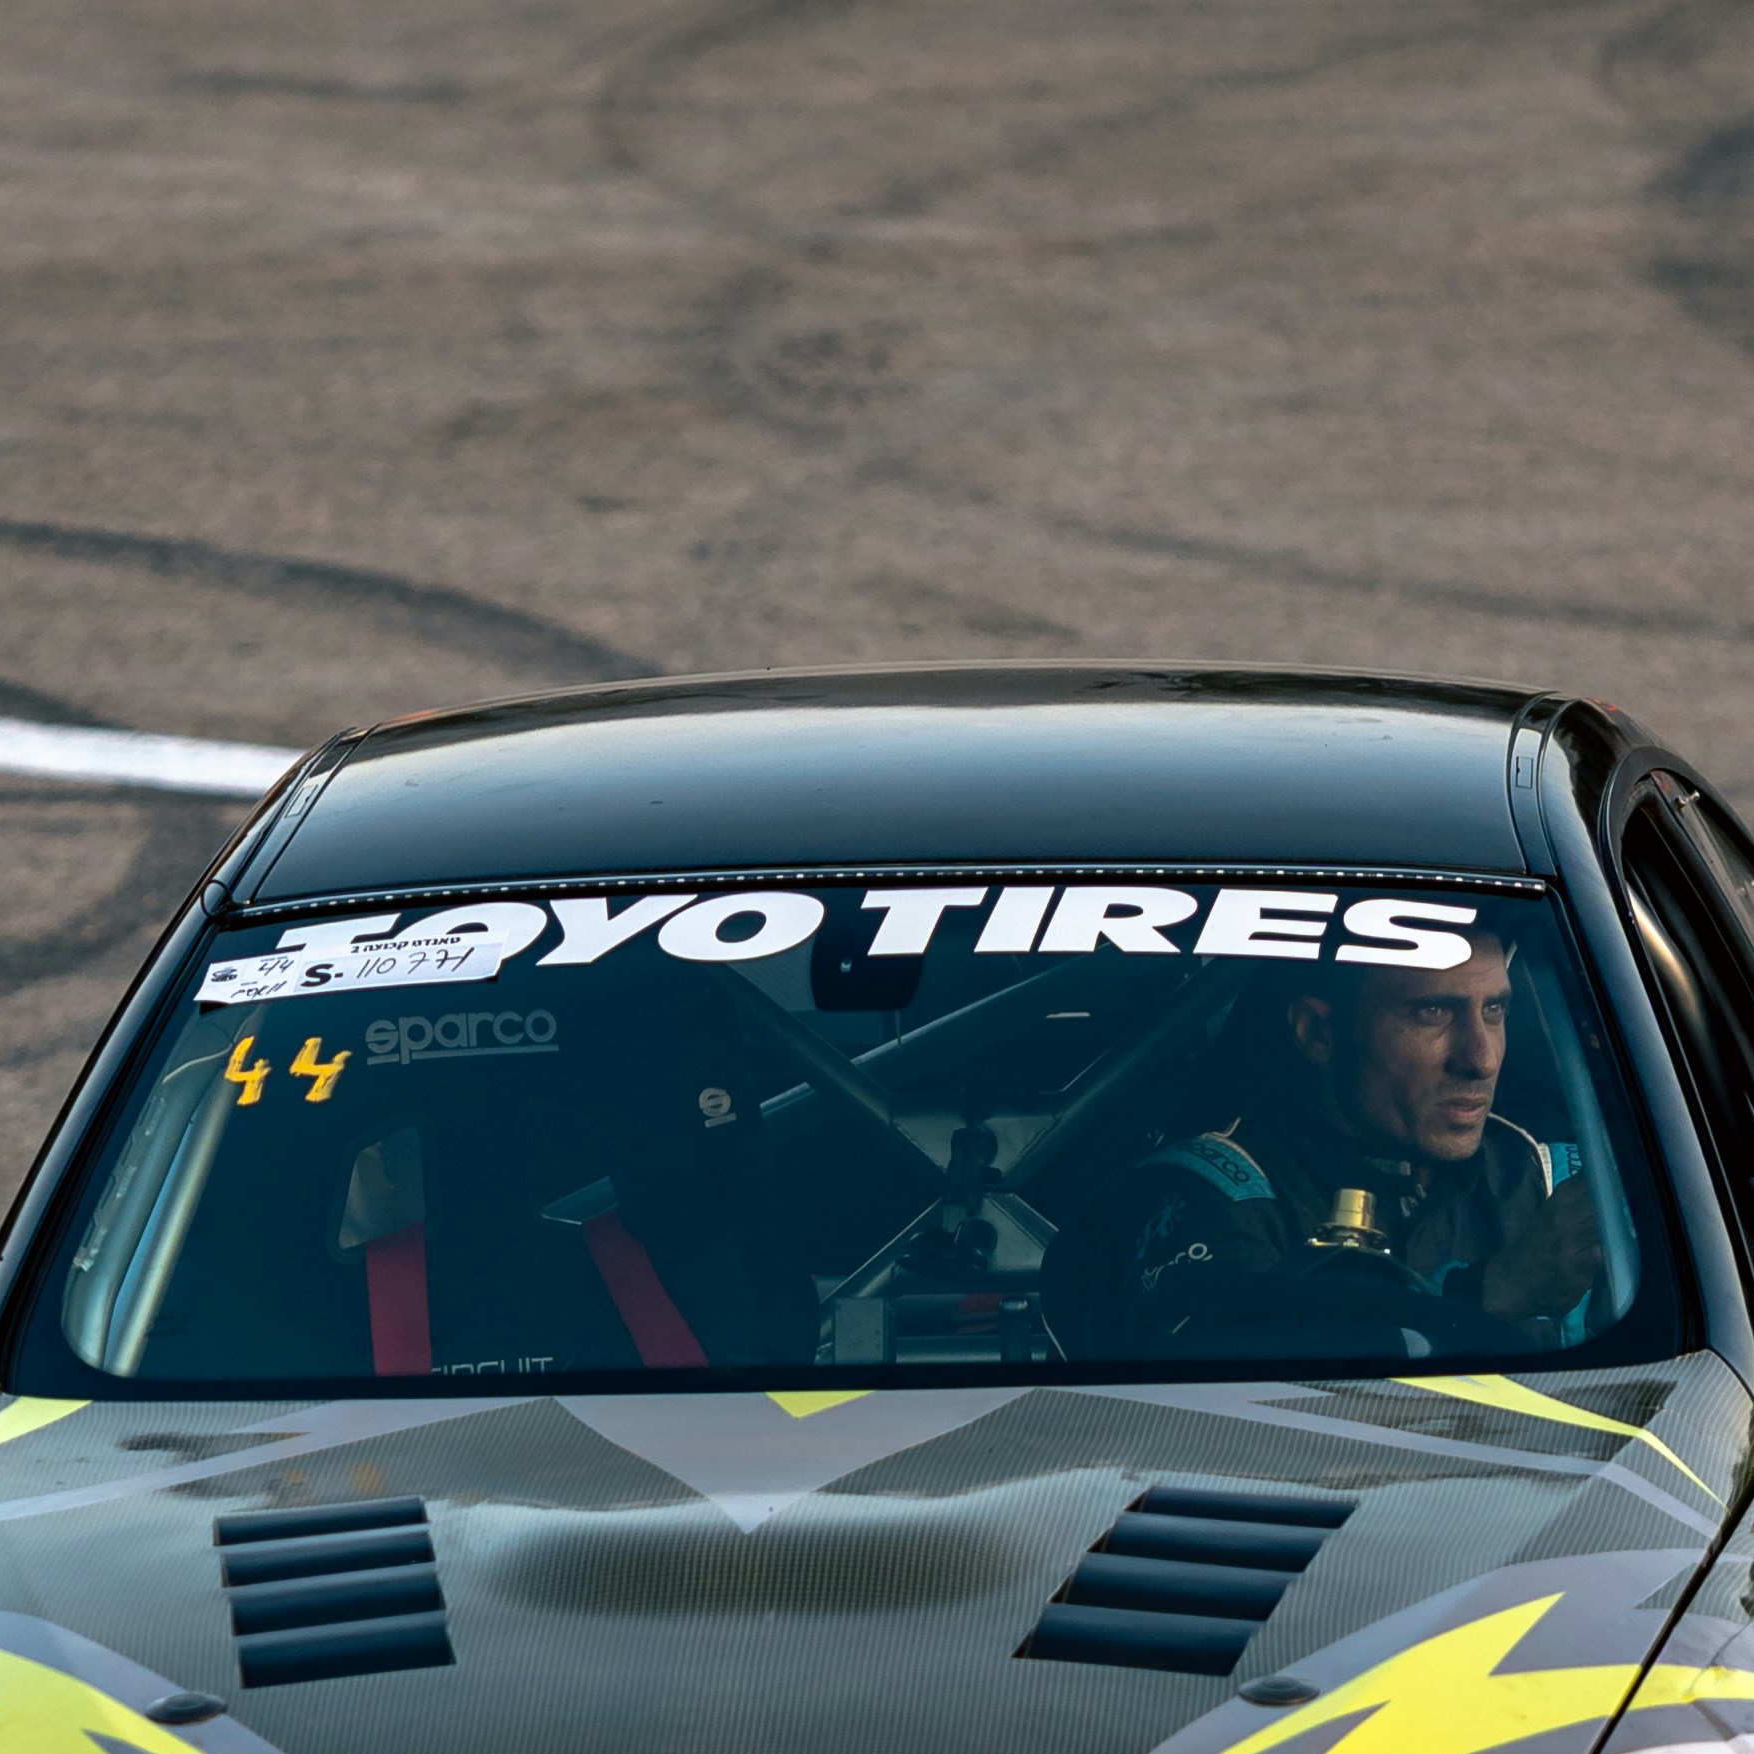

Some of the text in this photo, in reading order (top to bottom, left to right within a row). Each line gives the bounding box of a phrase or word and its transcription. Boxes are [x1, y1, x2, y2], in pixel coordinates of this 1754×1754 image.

[275, 886, 1478, 971] TOYO TIRES
[365, 1008, 558, 1065] sparco
[1179, 1140, 1250, 1184] parco
